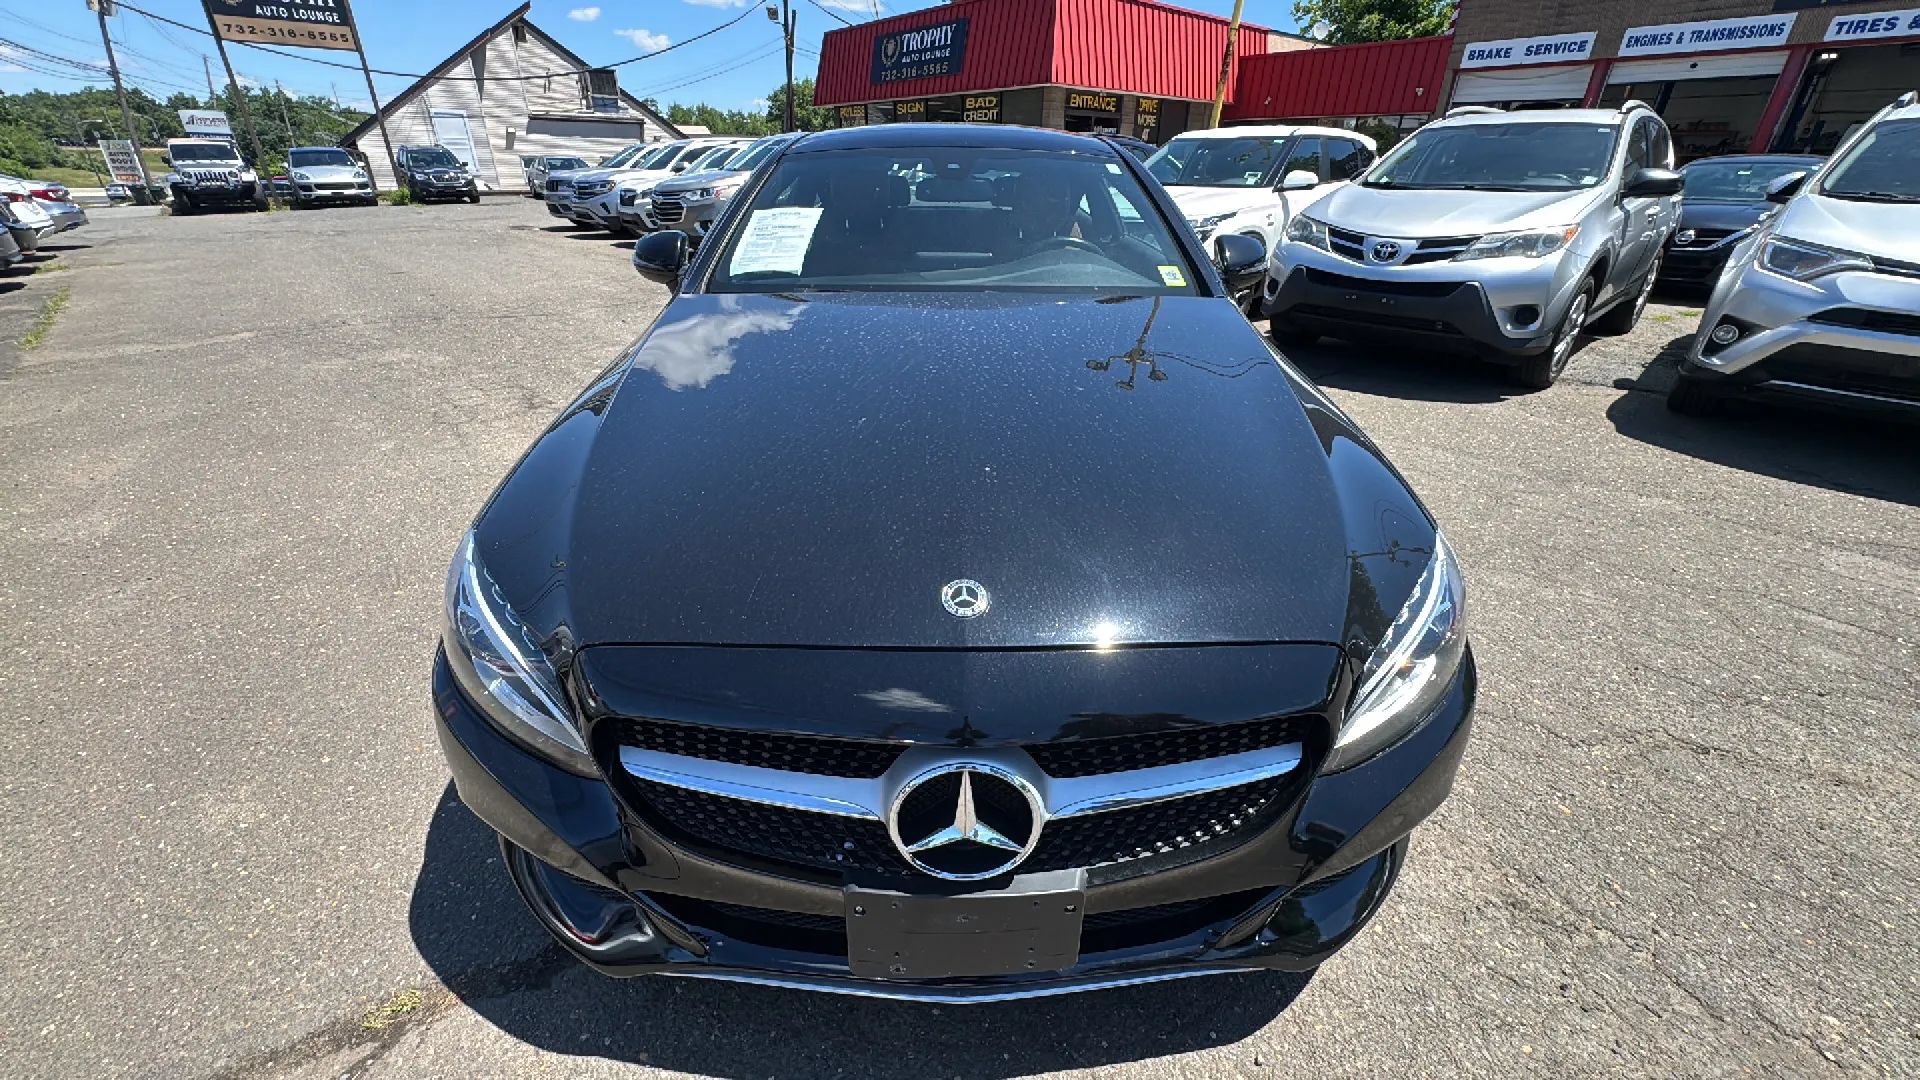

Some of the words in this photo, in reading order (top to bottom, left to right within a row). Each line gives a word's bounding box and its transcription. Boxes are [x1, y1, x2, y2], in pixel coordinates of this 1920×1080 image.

[255, 5, 289, 18] AUTO
[292, 8, 341, 23] LOUNGE
[1835, 16, 1900, 36] TIRES
[902, 24, 957, 52] TROPHY
[1625, 32, 1674, 48] ENGINES
[1676, 31, 1684, 44] &
[1689, 22, 1787, 43] TRANSMISSIONS
[901, 52, 920, 63] AUTO
[922, 48, 951, 60] LOUNGE
[1467, 47, 1513, 61] BRAKE
[1524, 39, 1589, 57] SERVICE
[897, 102, 924, 114] SIGN
[965, 97, 997, 109] BAD
[1070, 94, 1117, 112] ENTRANCE
[1138, 98, 1159, 113] DRIVE
[963, 109, 999, 122] CREDIT
[1137, 114, 1157, 127] MORE
